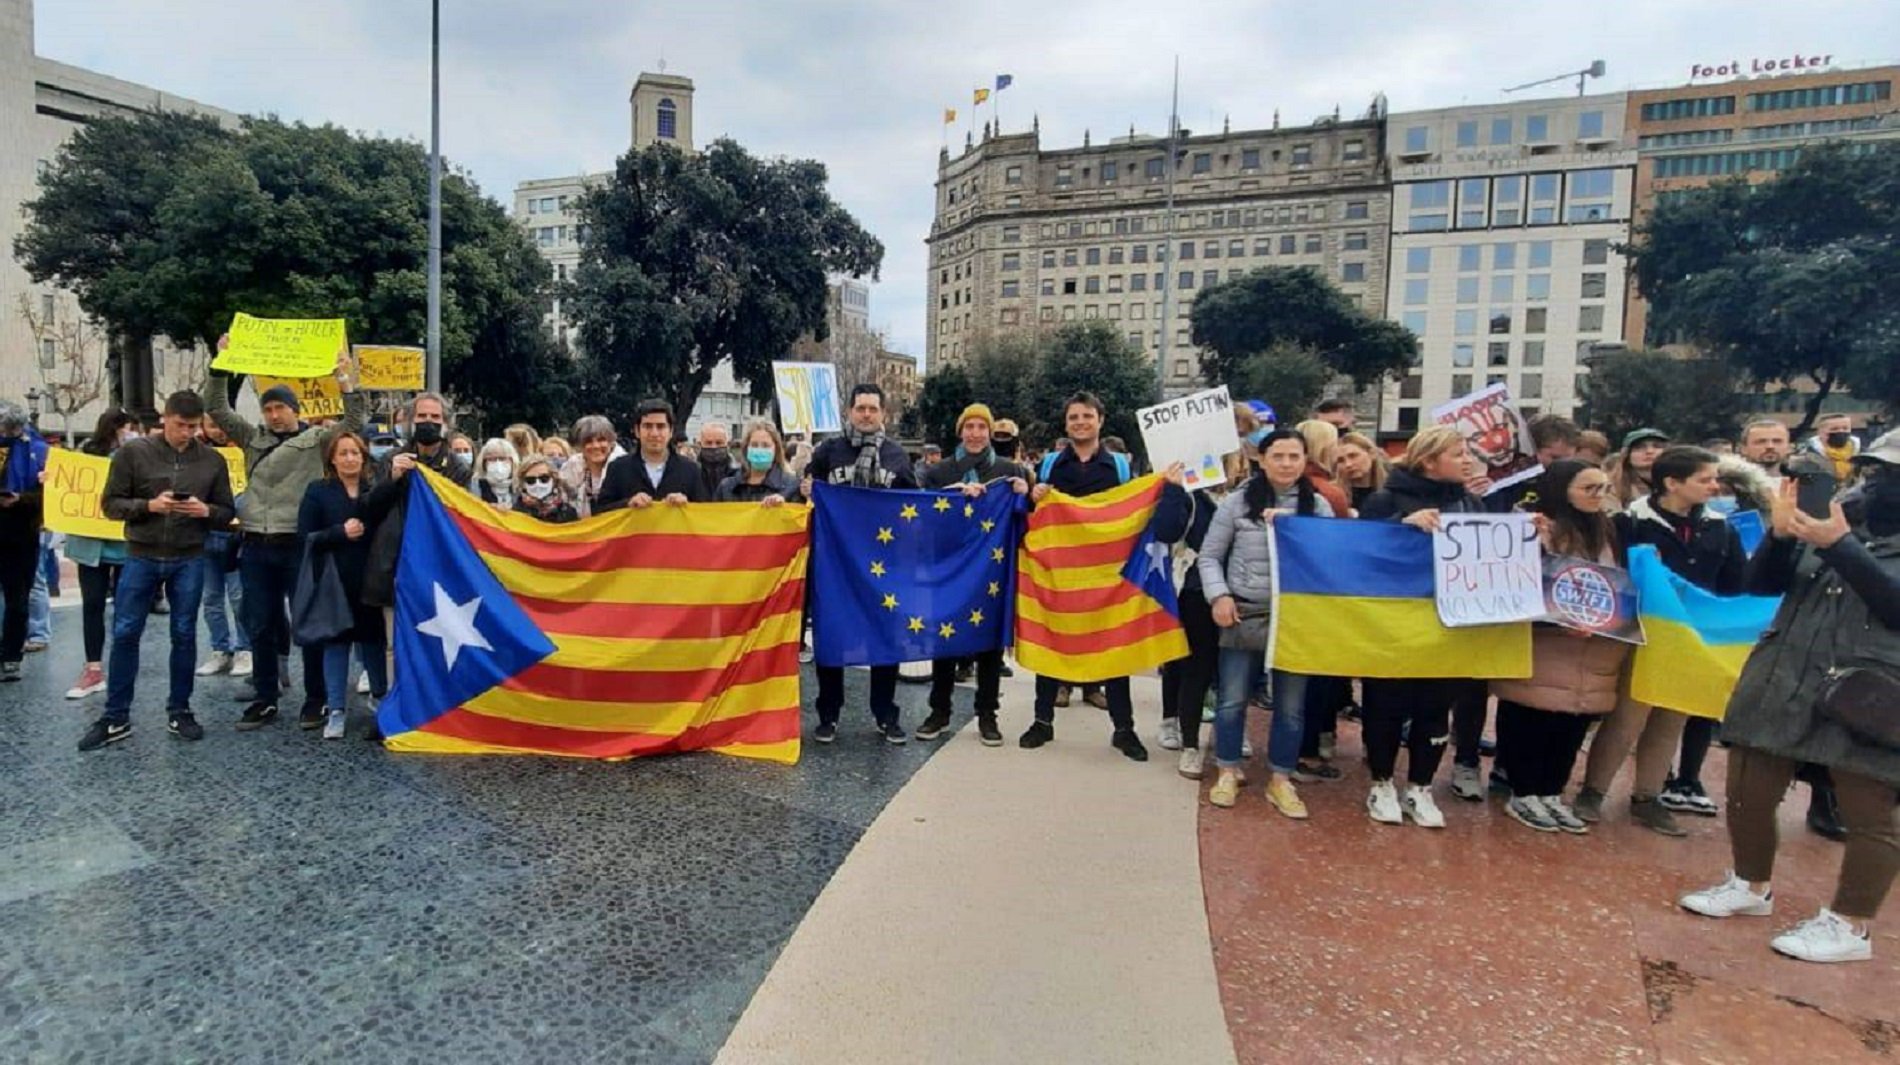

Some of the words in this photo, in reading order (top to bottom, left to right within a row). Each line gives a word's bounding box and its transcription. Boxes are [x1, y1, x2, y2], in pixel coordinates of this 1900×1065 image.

[1691, 60, 1740, 77] Foot
[1752, 54, 1833, 72] Locker
[1143, 404, 1180, 430] STOP
[54, 463, 98, 494] NO
[1441, 520, 1538, 562] STOP
[1446, 560, 1538, 592] PUTIN
[1557, 584, 1609, 609] SWIFT
